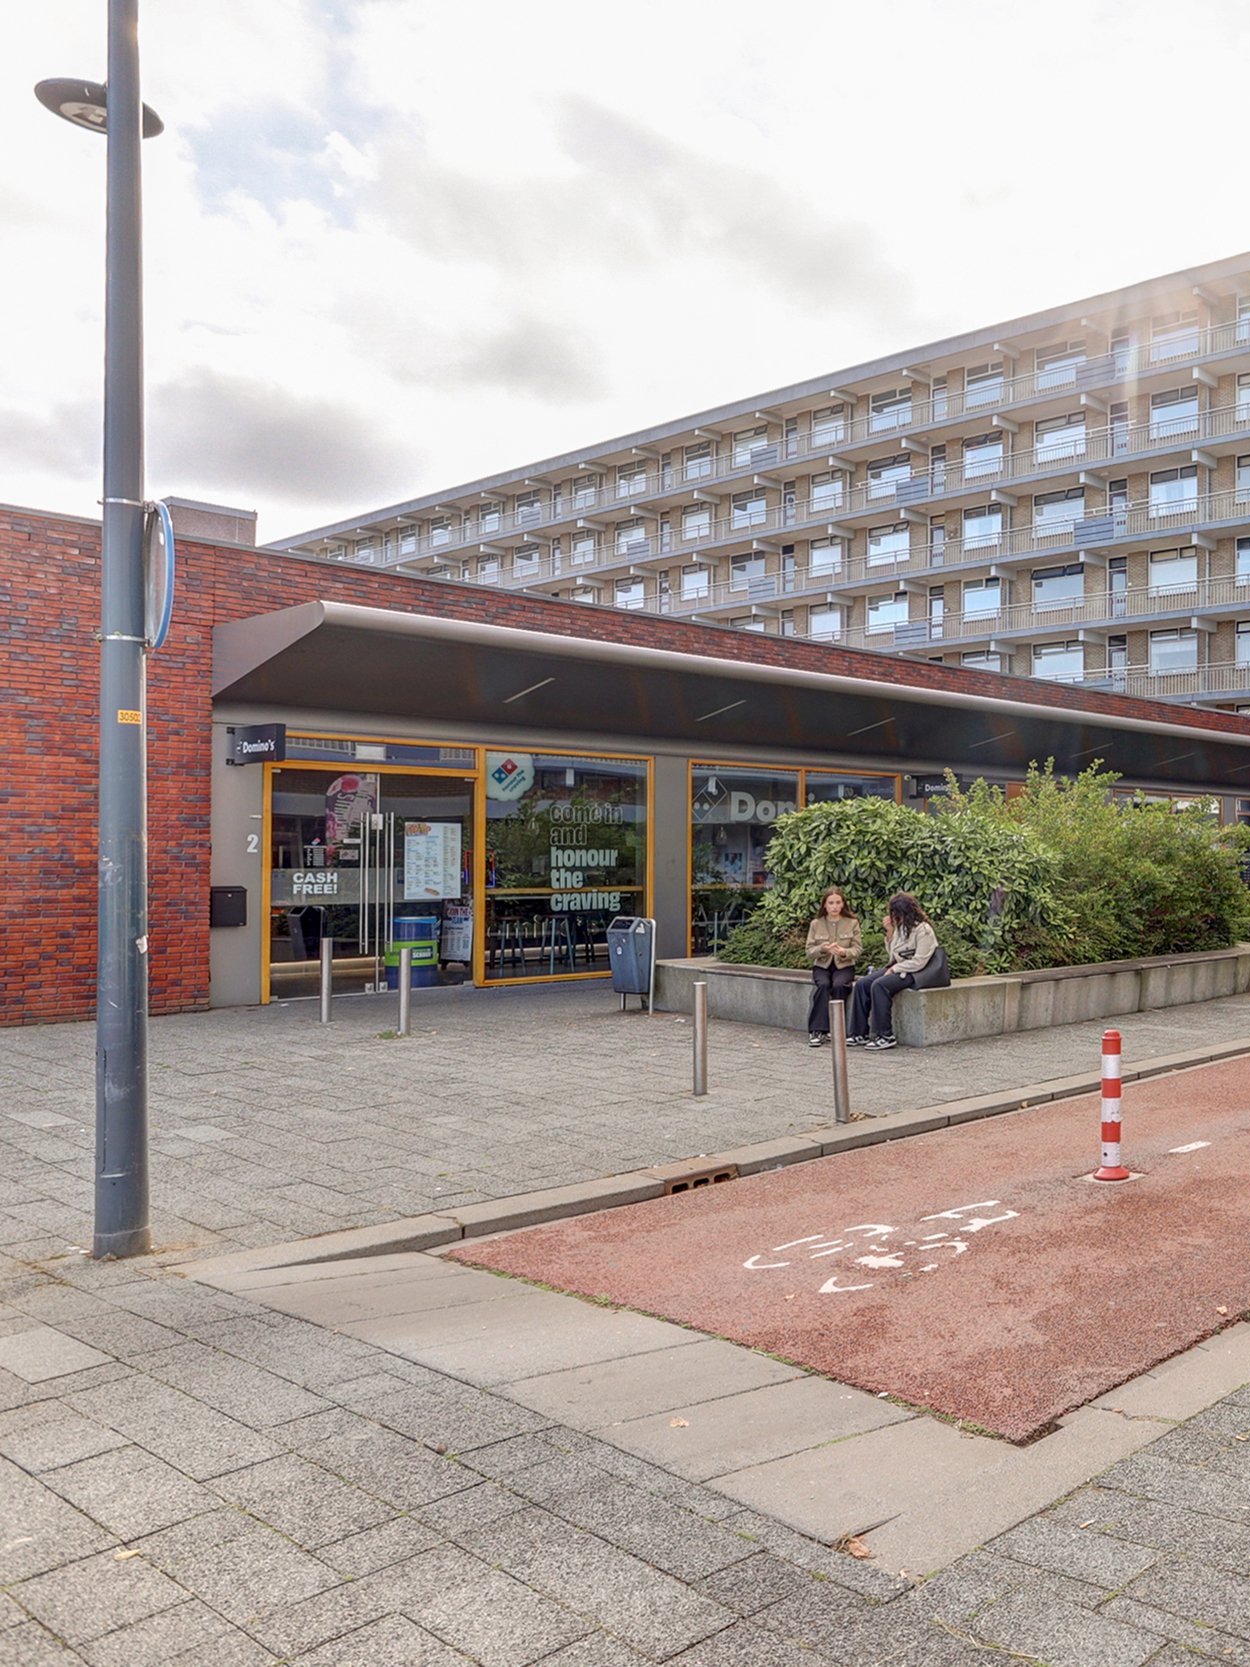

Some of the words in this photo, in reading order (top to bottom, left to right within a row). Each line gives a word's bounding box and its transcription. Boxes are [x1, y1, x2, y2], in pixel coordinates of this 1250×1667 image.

[242, 739, 275, 754] Domino's
[551, 804, 602, 824] come
[604, 802, 623, 824] in
[246, 833, 259, 853] 2
[550, 824, 587, 846] and
[551, 846, 618, 868] honour
[292, 872, 338, 883] CASH
[551, 868, 584, 889] the
[292, 884, 338, 895] FREE!
[551, 889, 621, 912] craving
